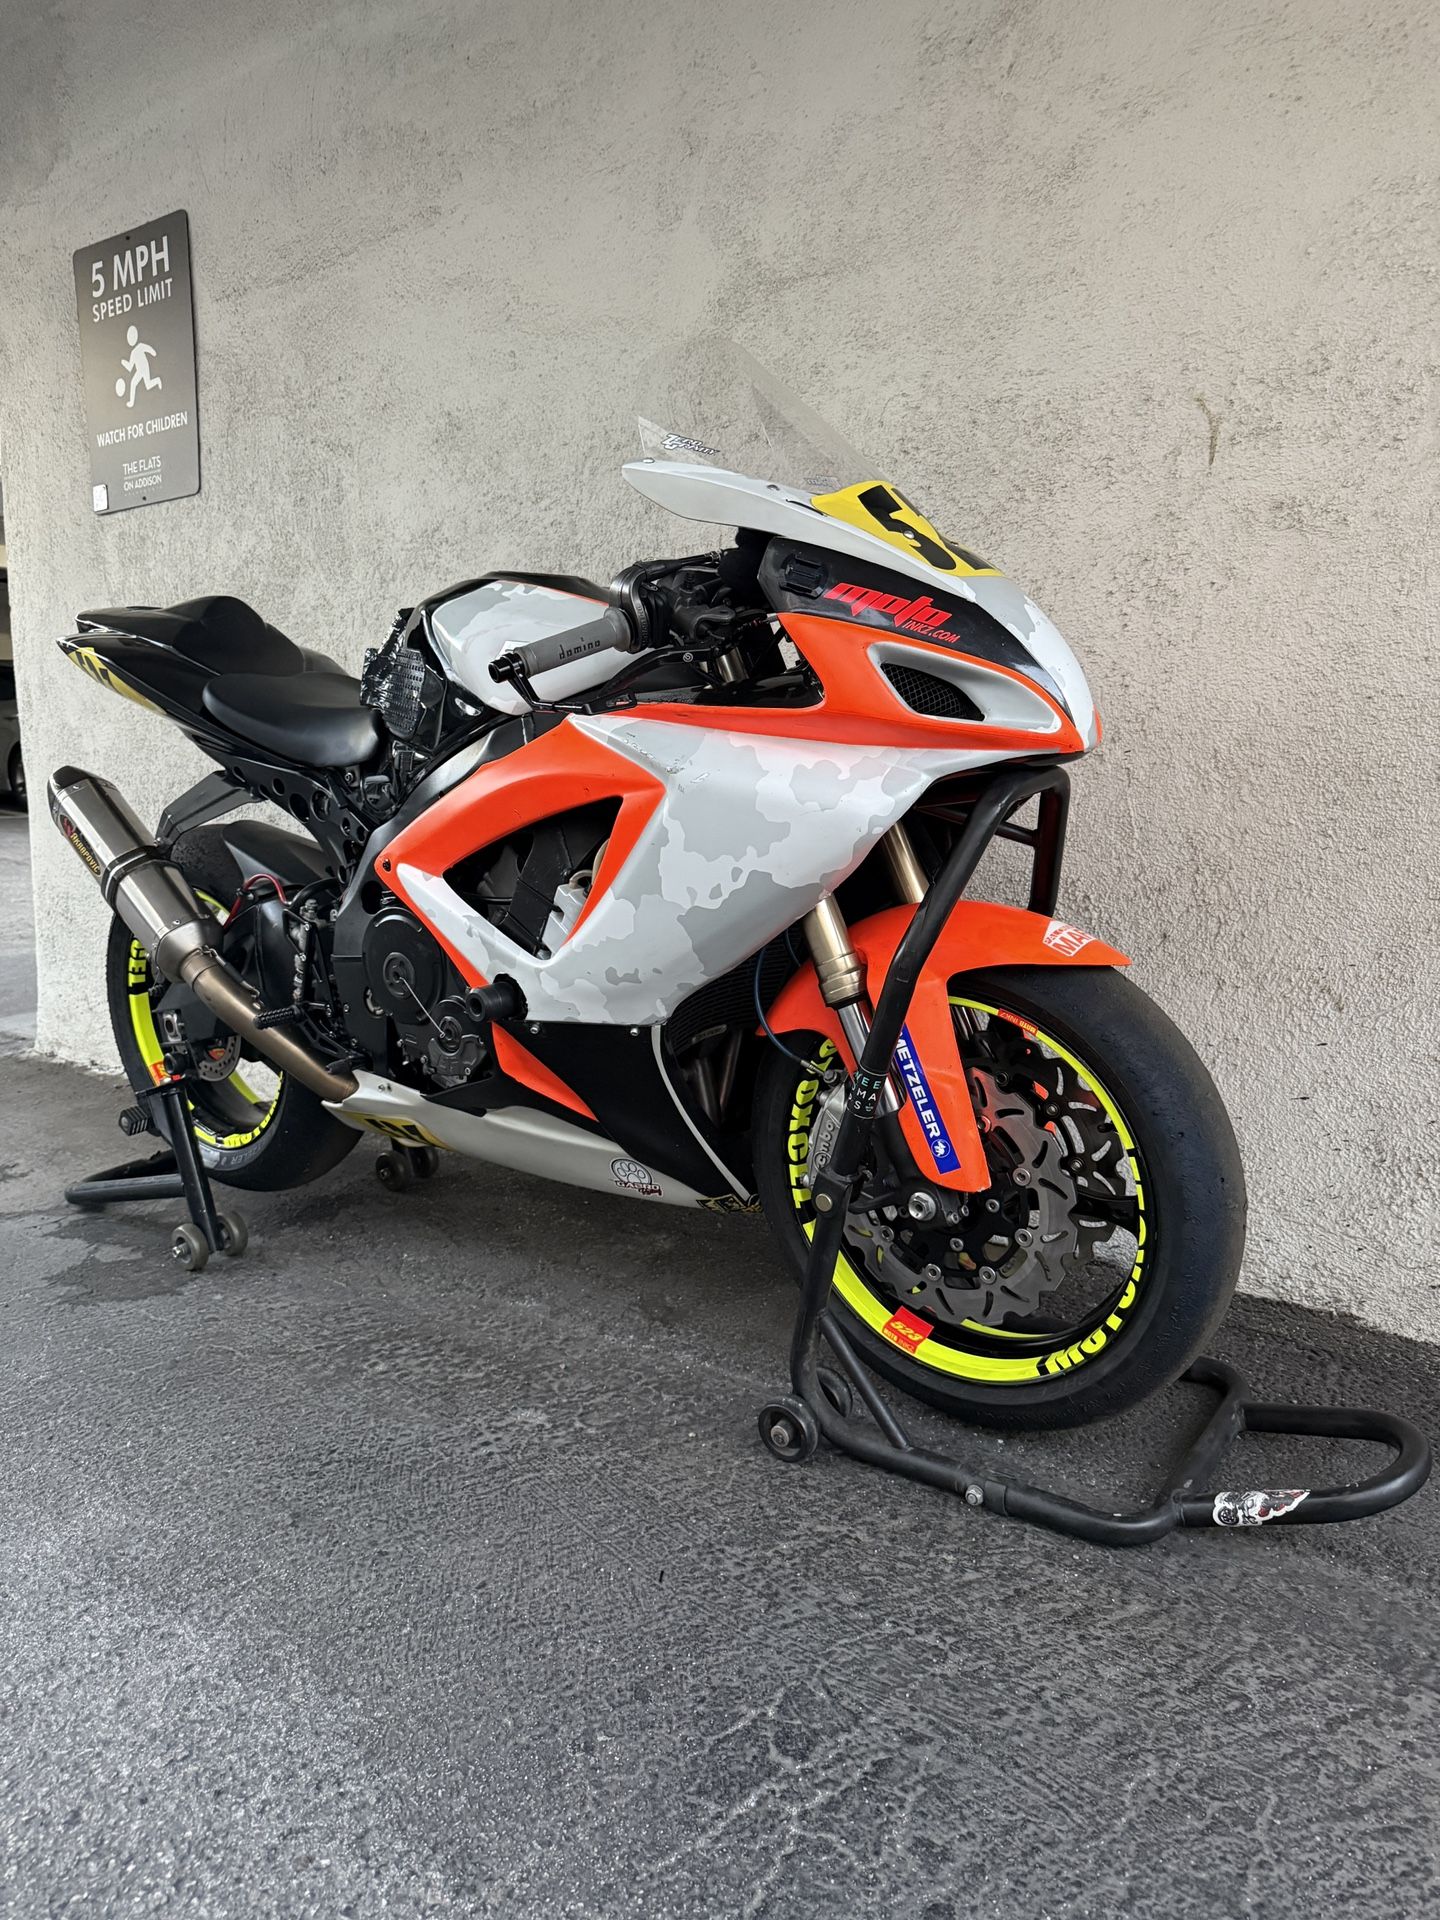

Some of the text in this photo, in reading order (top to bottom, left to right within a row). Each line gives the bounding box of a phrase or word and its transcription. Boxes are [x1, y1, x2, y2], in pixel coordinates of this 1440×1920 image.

[91, 235, 170, 298] 5 MPH
[92, 277, 173, 323] SPEED LIMIT
[96, 410, 188, 447] WATCH FOR CHILDREN
[122, 455, 162, 475] THE FLATS
[123, 475, 162, 491] ON ADDISON
[558, 636, 601, 660] domino
